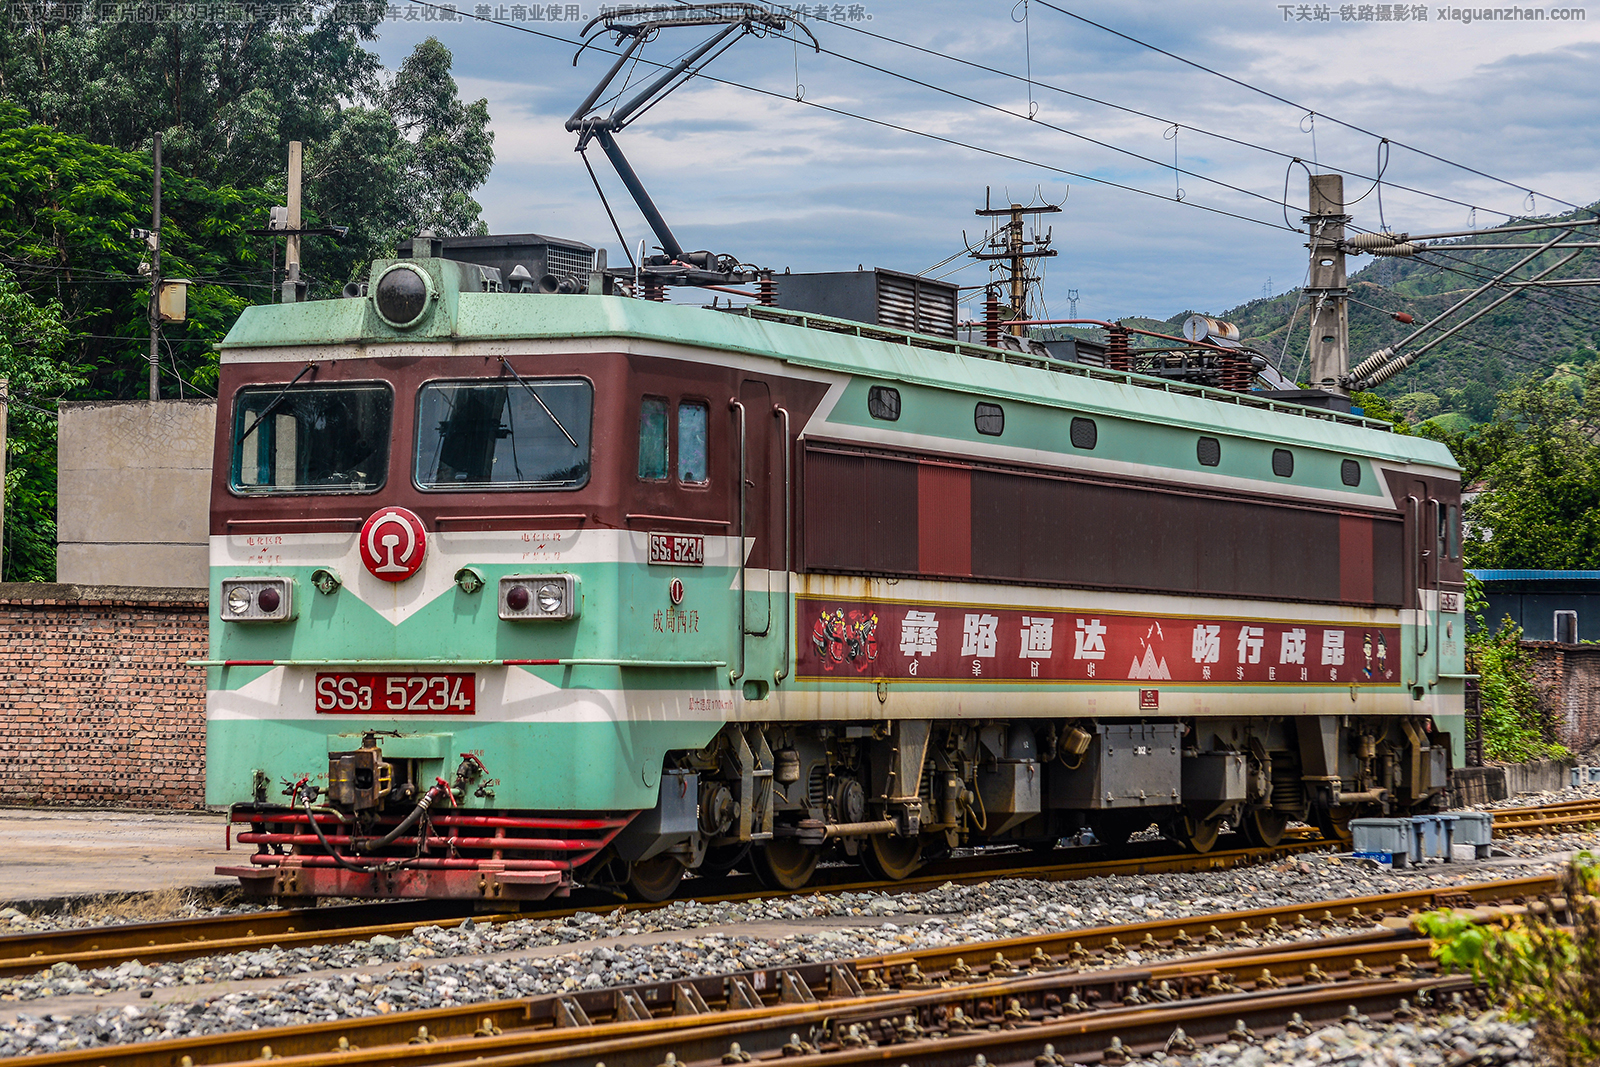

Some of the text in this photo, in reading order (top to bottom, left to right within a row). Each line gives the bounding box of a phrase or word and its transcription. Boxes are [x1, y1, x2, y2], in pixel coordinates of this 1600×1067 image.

[652, 536, 704, 562] SS3 5234
[653, 609, 699, 633] 成局西段
[900, 610, 1345, 666] 彝路通达 畅行成昆
[317, 677, 471, 710] SS3 5234
